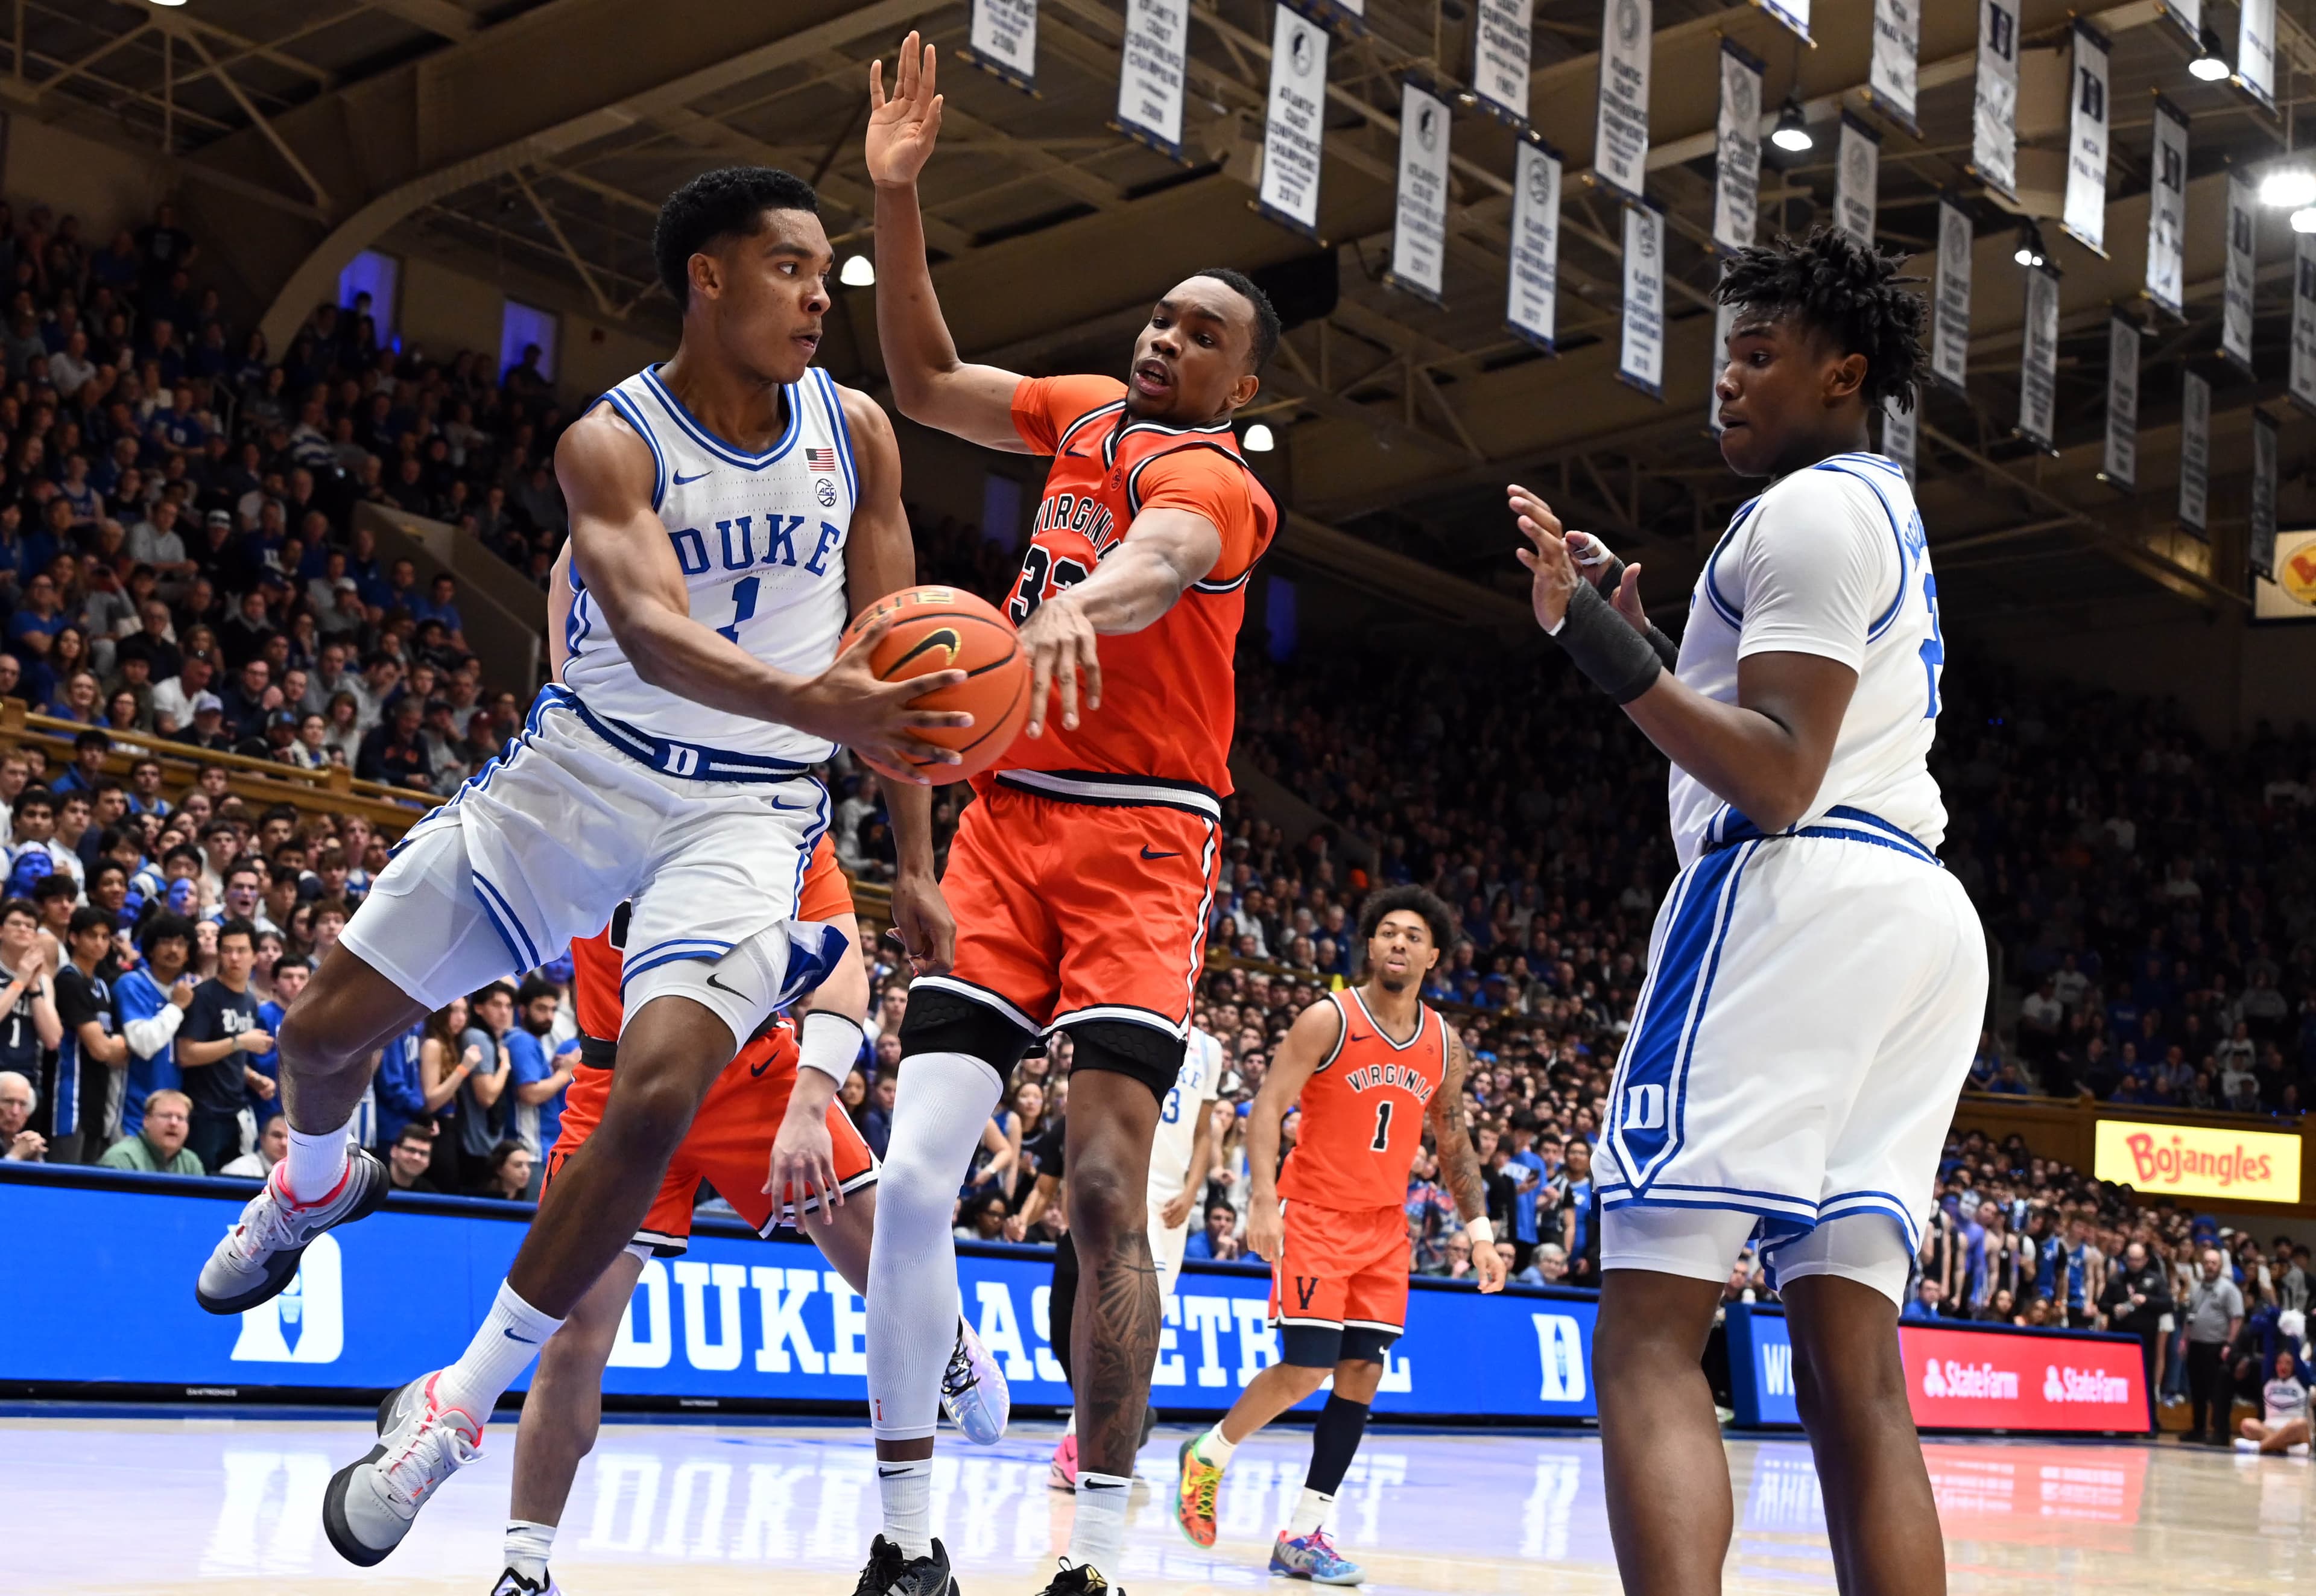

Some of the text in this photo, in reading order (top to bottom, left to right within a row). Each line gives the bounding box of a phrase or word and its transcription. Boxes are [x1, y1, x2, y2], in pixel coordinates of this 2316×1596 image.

[668, 513, 841, 577] DUKE
[716, 575, 761, 645] 1
[1345, 1063, 1434, 1105] VIRGINIA
[1370, 1100, 1394, 1153] 1
[2125, 1132, 2271, 1186] Bojangles
[606, 1258, 867, 1376] DUKE
[1295, 1276, 1319, 1310] V
